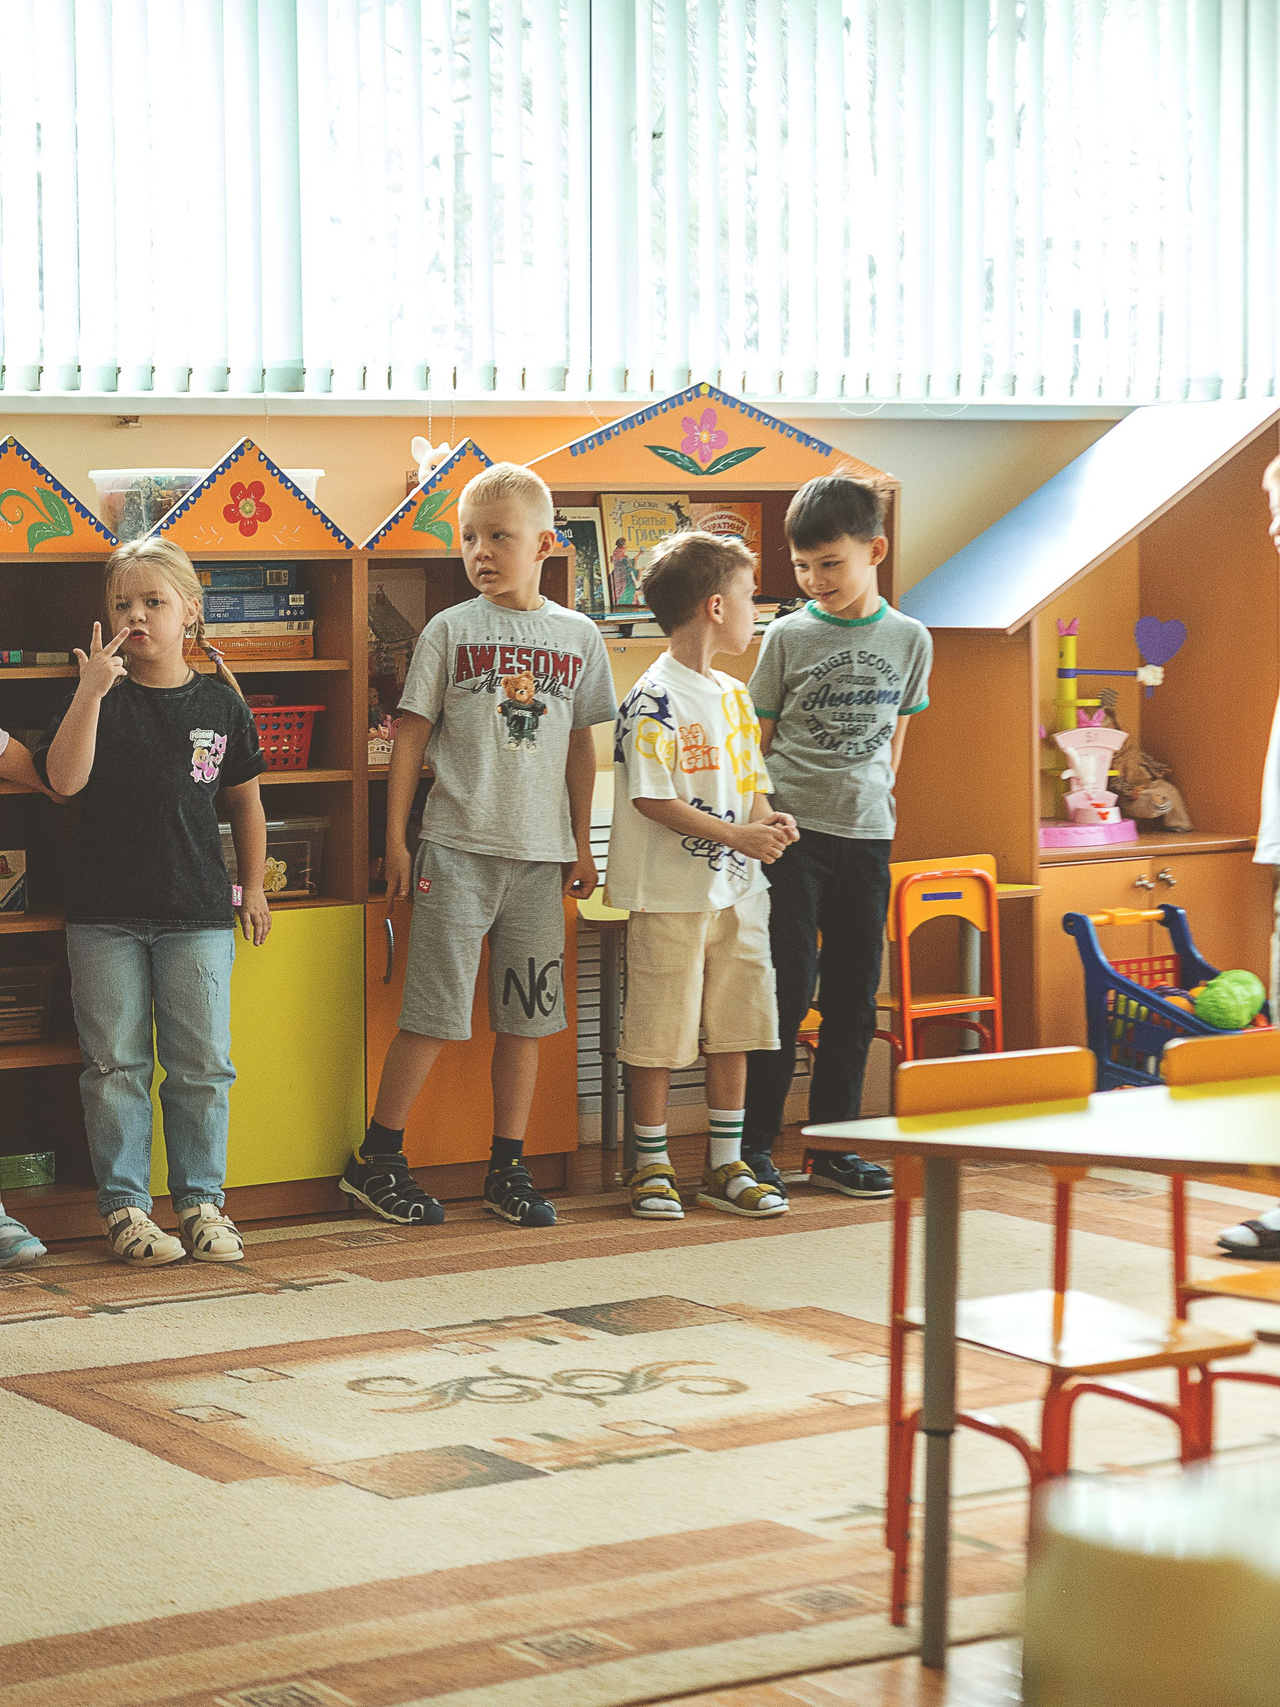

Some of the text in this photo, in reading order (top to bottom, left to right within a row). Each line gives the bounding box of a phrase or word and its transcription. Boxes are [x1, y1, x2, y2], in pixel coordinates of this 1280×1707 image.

[631, 515, 667, 527] Братья
[810, 650, 900, 686] HIGH SCORE
[800, 683, 901, 711] Awesome
